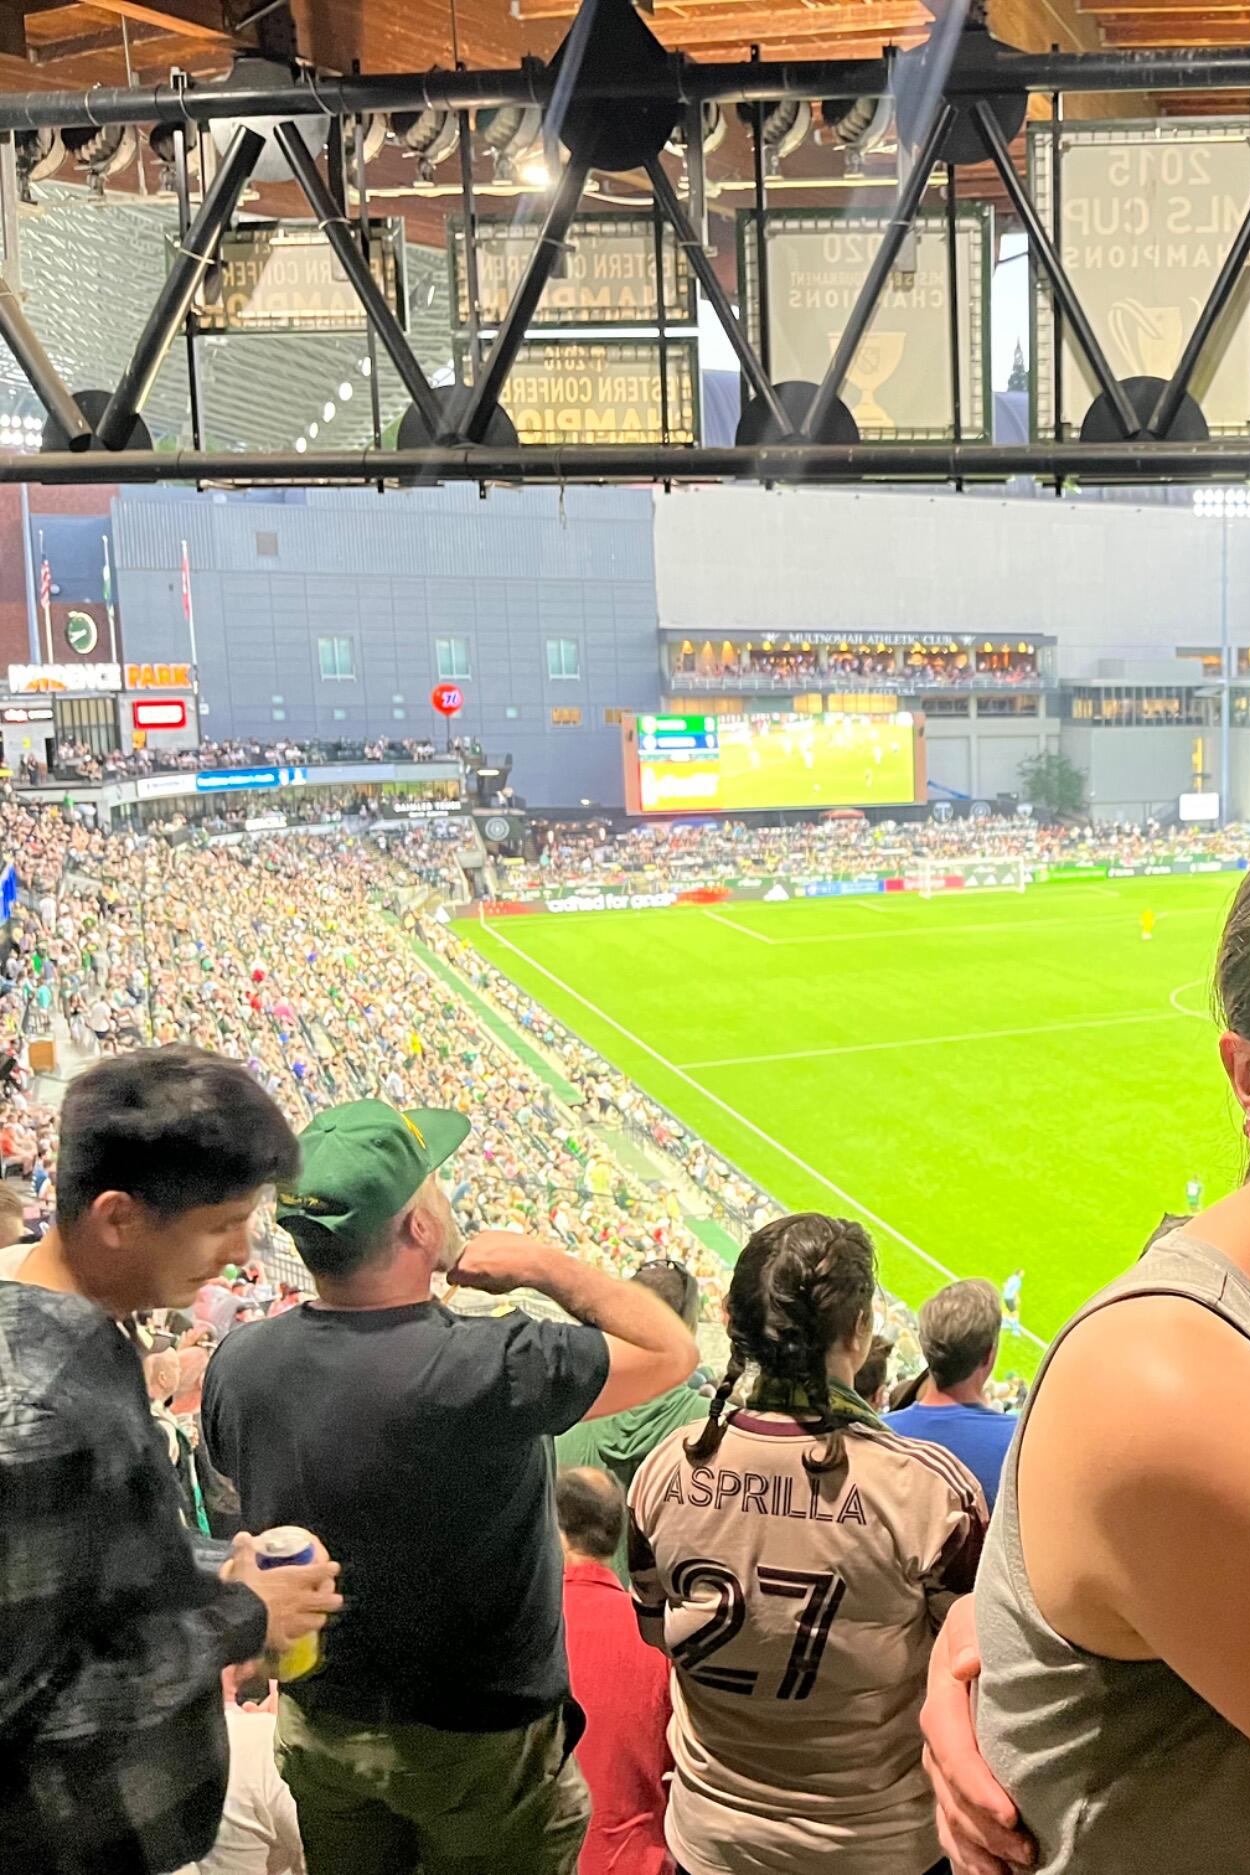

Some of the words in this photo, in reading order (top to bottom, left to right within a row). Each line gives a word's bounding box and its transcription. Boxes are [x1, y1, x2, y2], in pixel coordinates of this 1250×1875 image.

[789, 632, 864, 645] MULTNOMAH
[867, 633, 915, 645] ATHLETIC
[125, 664, 192, 690] PARK
[664, 1466, 867, 1525] ASPRILLA
[671, 1558, 847, 1700] 27
